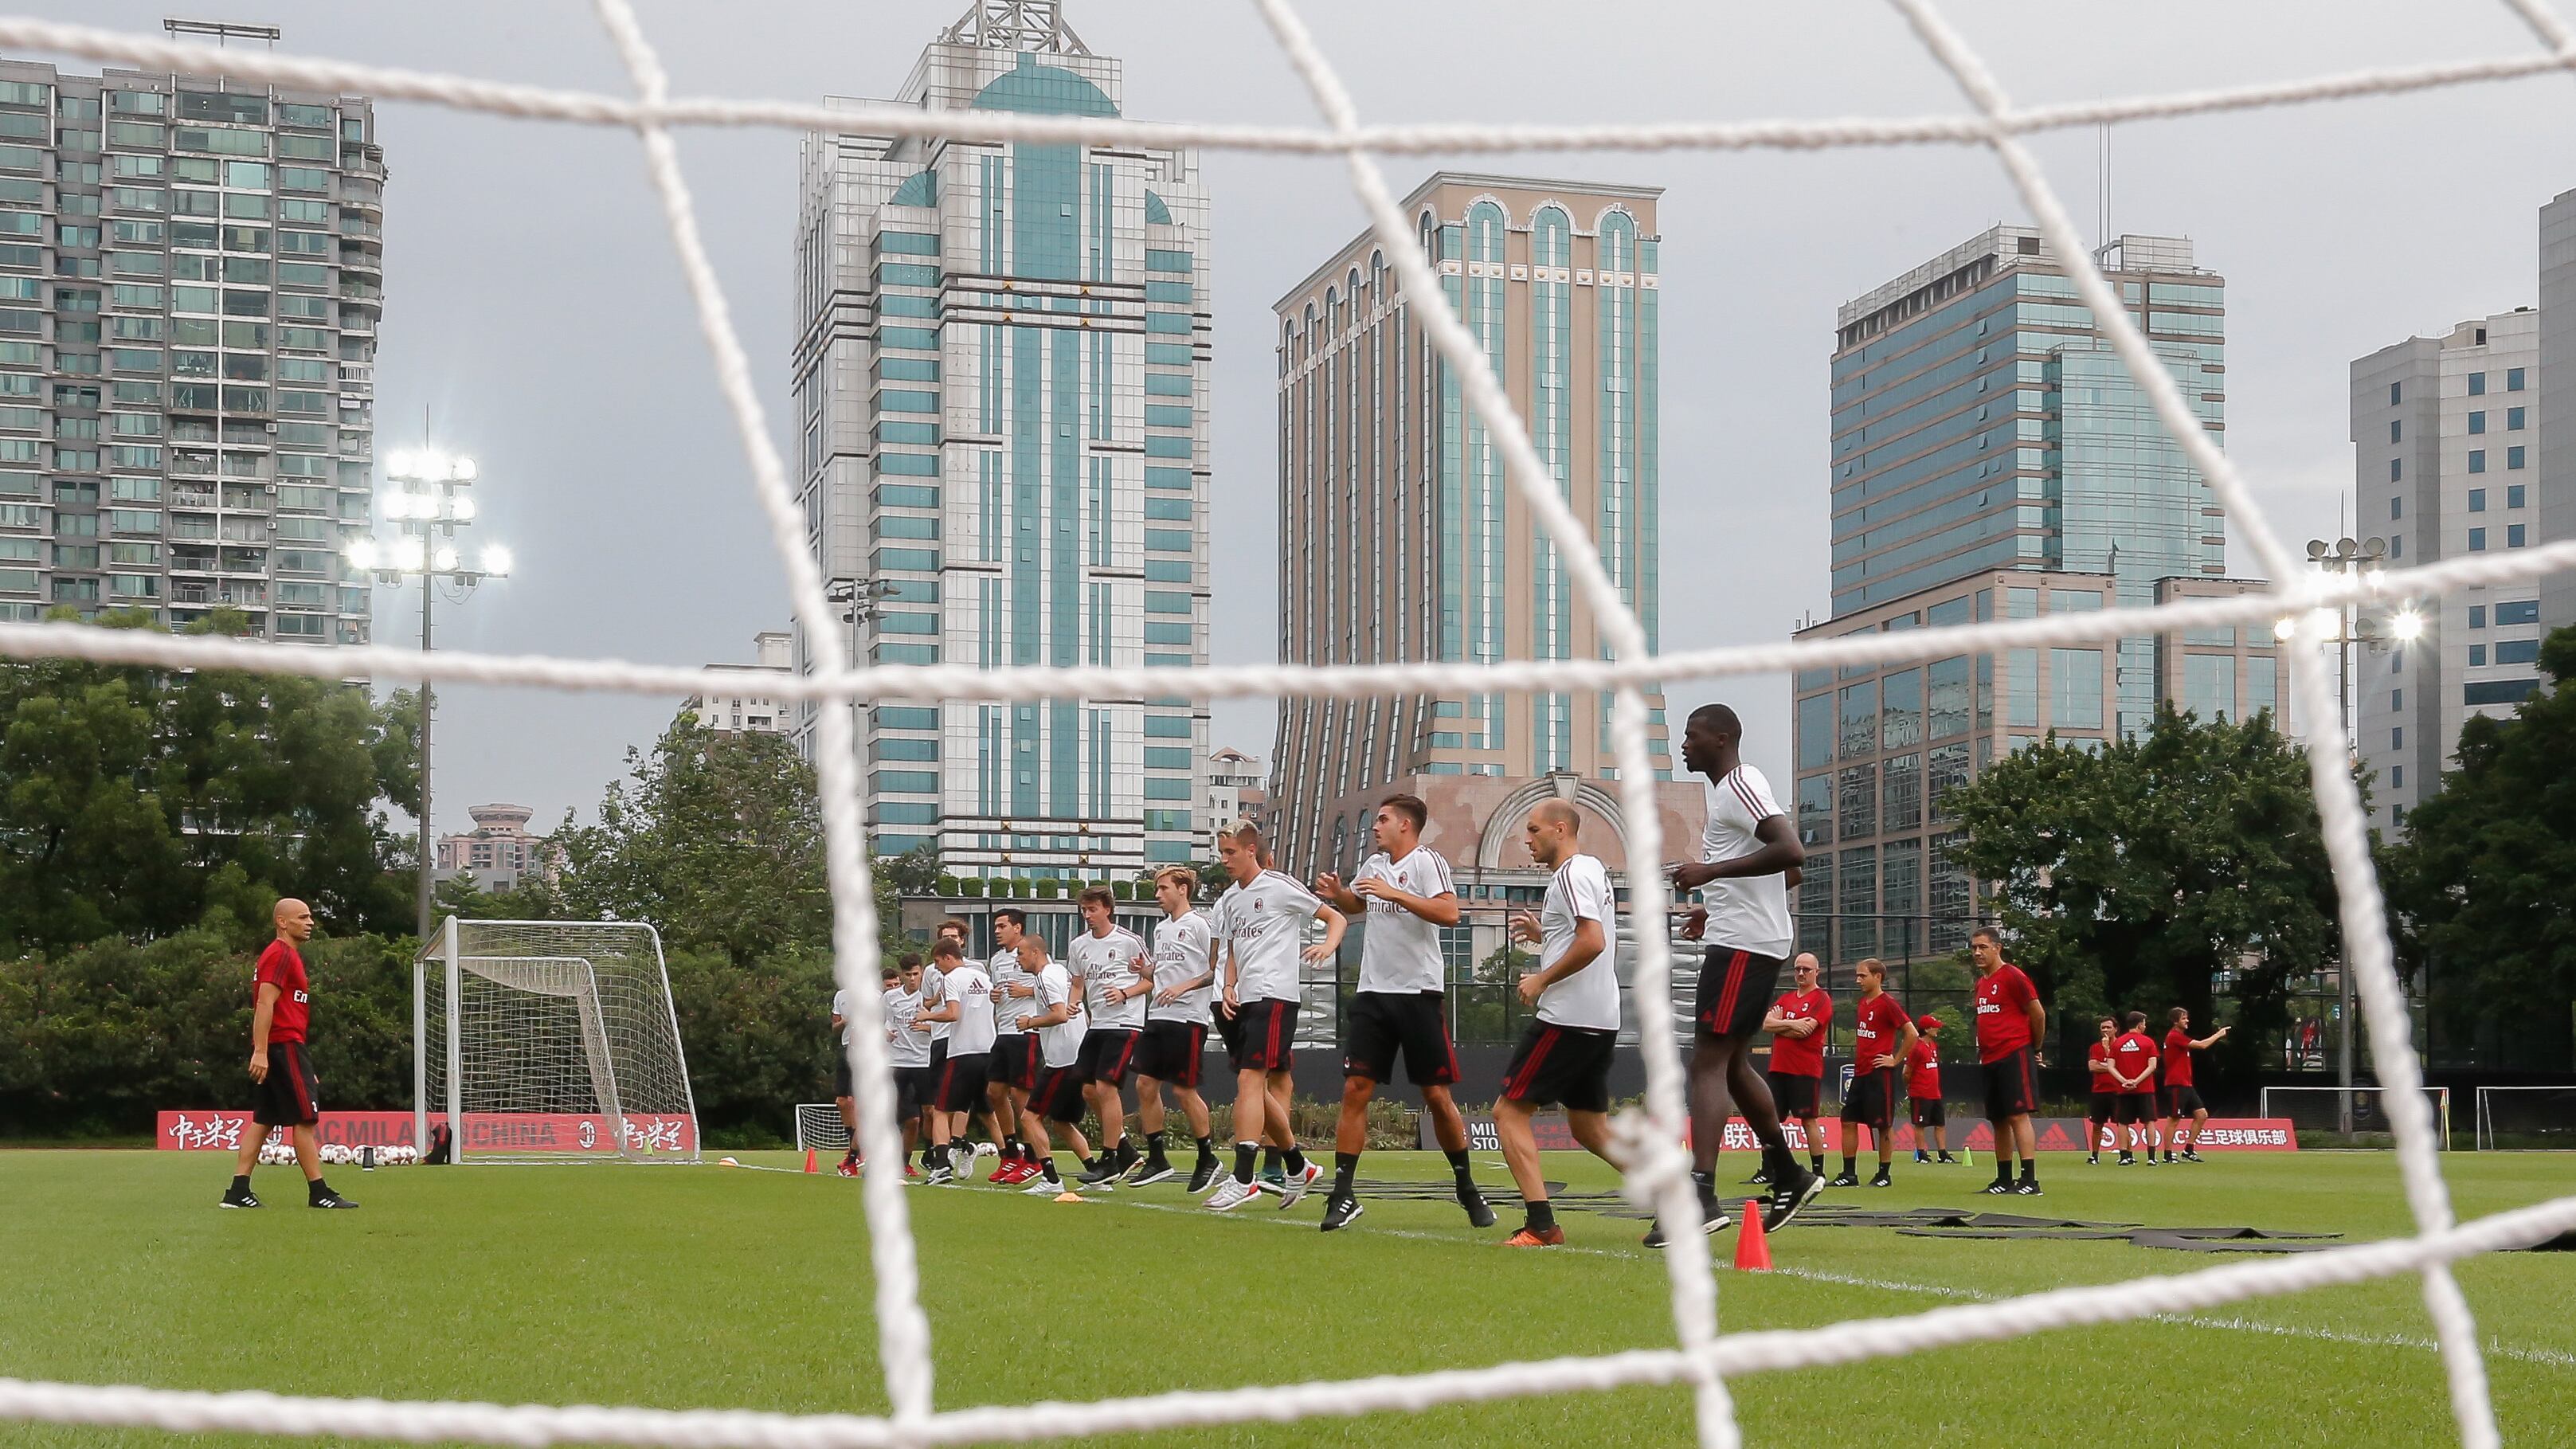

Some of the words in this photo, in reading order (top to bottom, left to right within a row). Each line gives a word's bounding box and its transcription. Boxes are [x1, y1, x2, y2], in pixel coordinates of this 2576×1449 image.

[346, 1121, 433, 1145] MILA
[472, 1122, 557, 1145] CHINA
[1471, 1123, 1497, 1136] MIL
[1474, 1138, 1502, 1150] STO
[2173, 1130, 2288, 1145] C兰足球俱乐部
